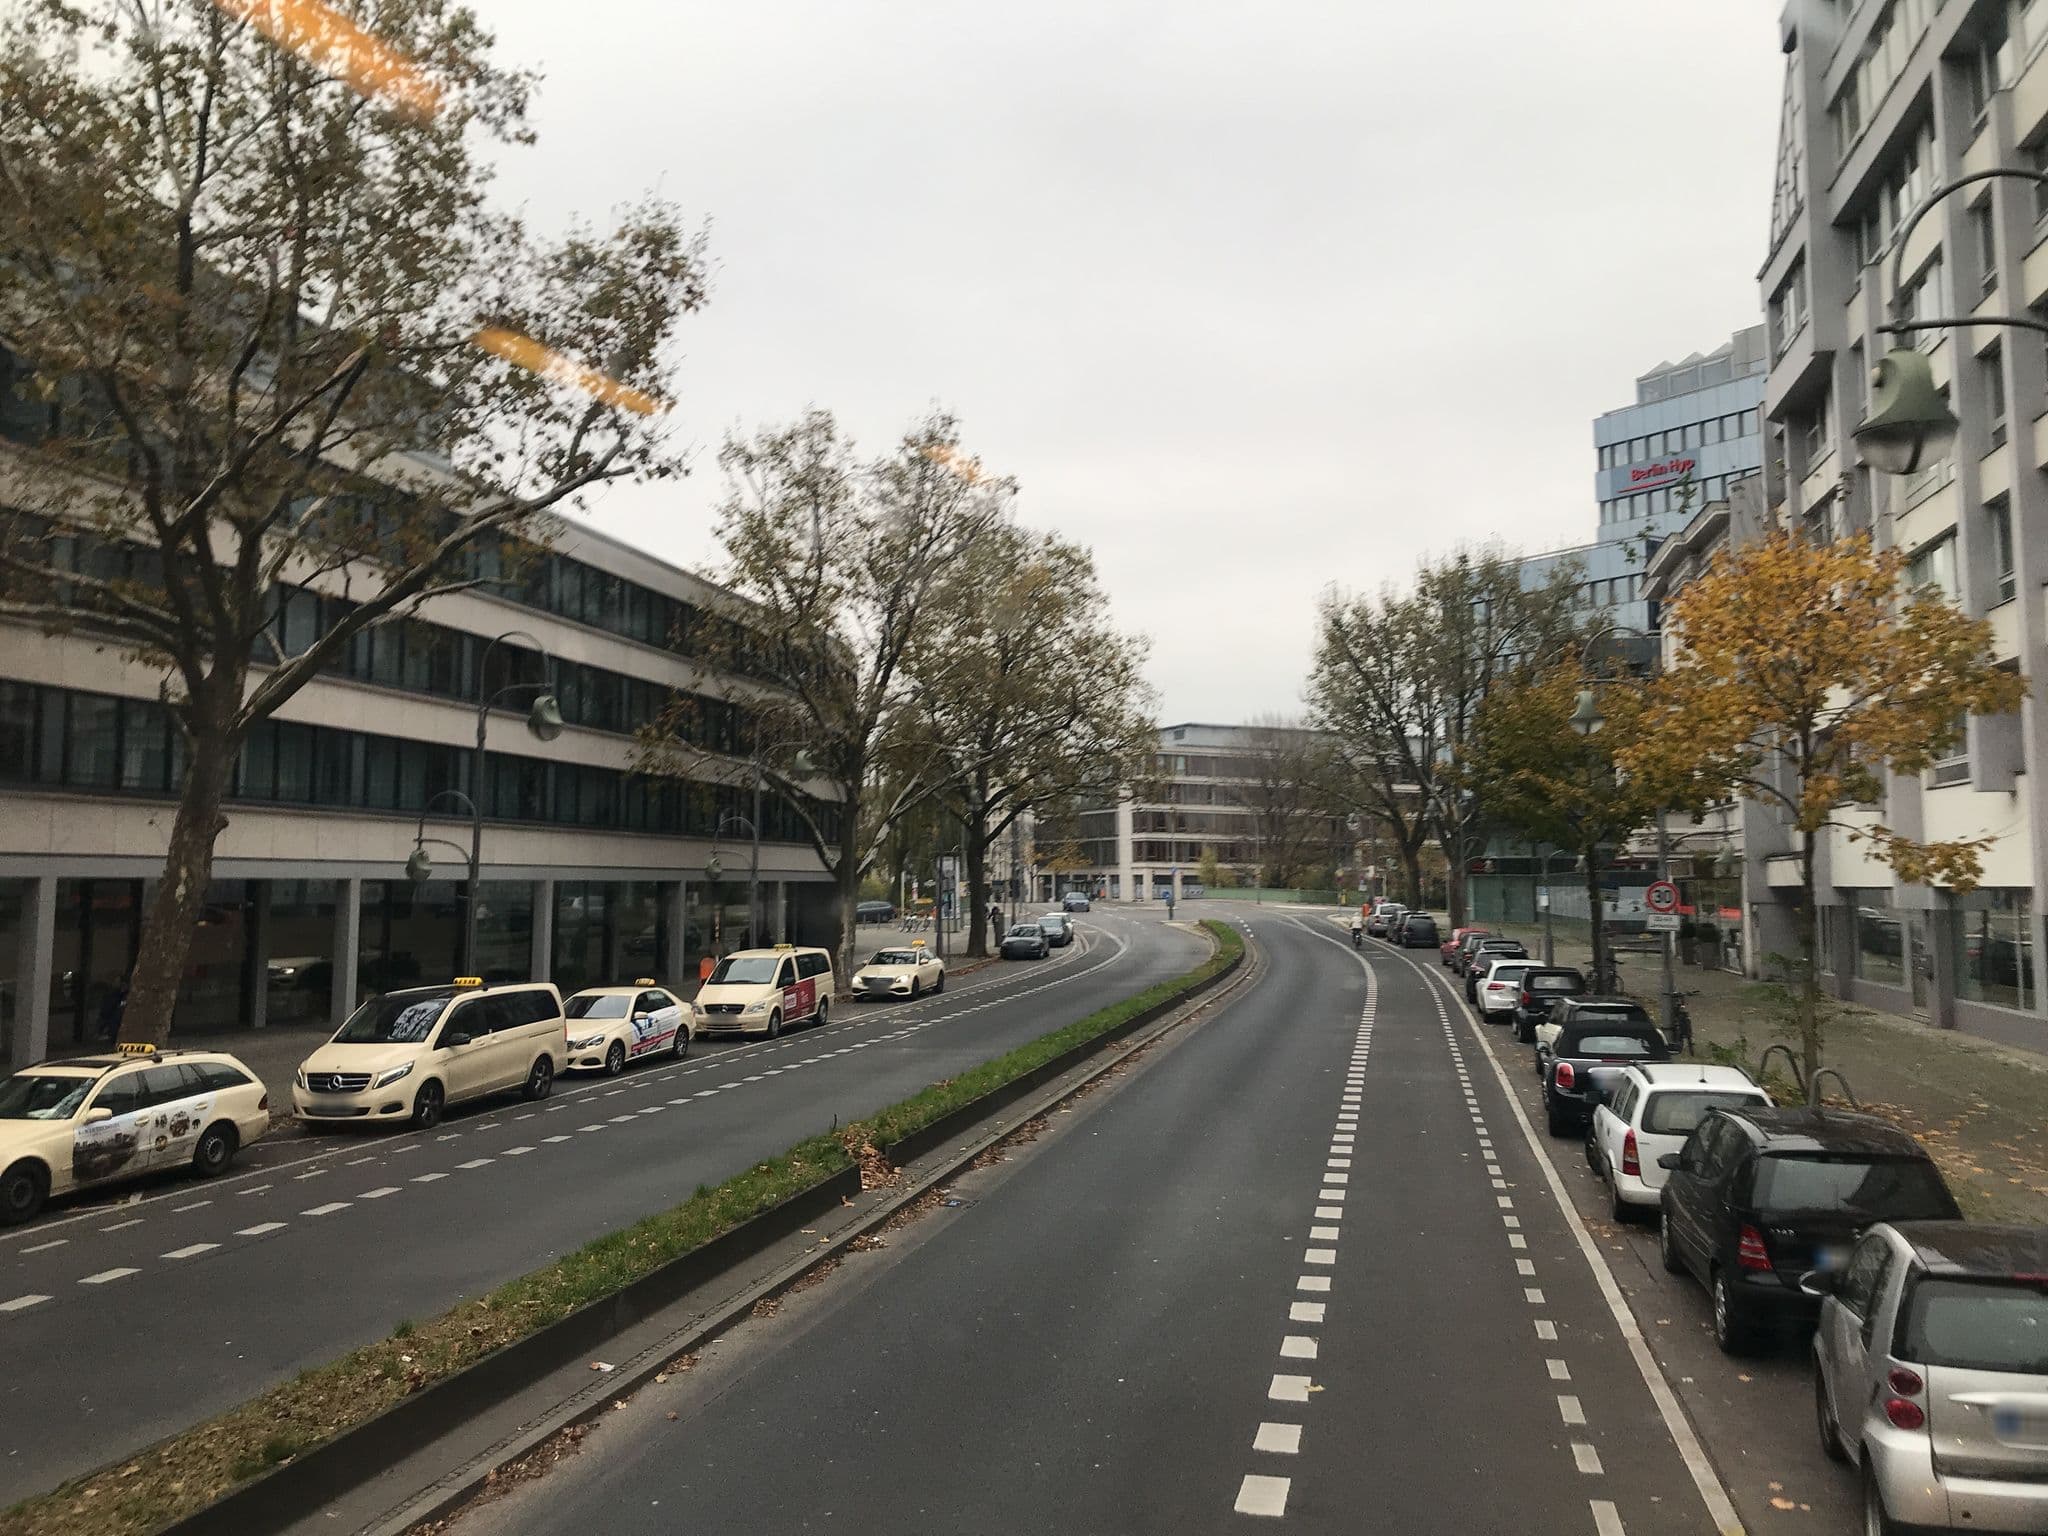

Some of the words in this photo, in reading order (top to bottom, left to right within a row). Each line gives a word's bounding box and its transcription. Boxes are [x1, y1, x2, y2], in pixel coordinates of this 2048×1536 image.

[1631, 463, 1667, 481] Berlin
[1669, 459, 1695, 474] Hyp
[1654, 889, 1672, 904] 30
